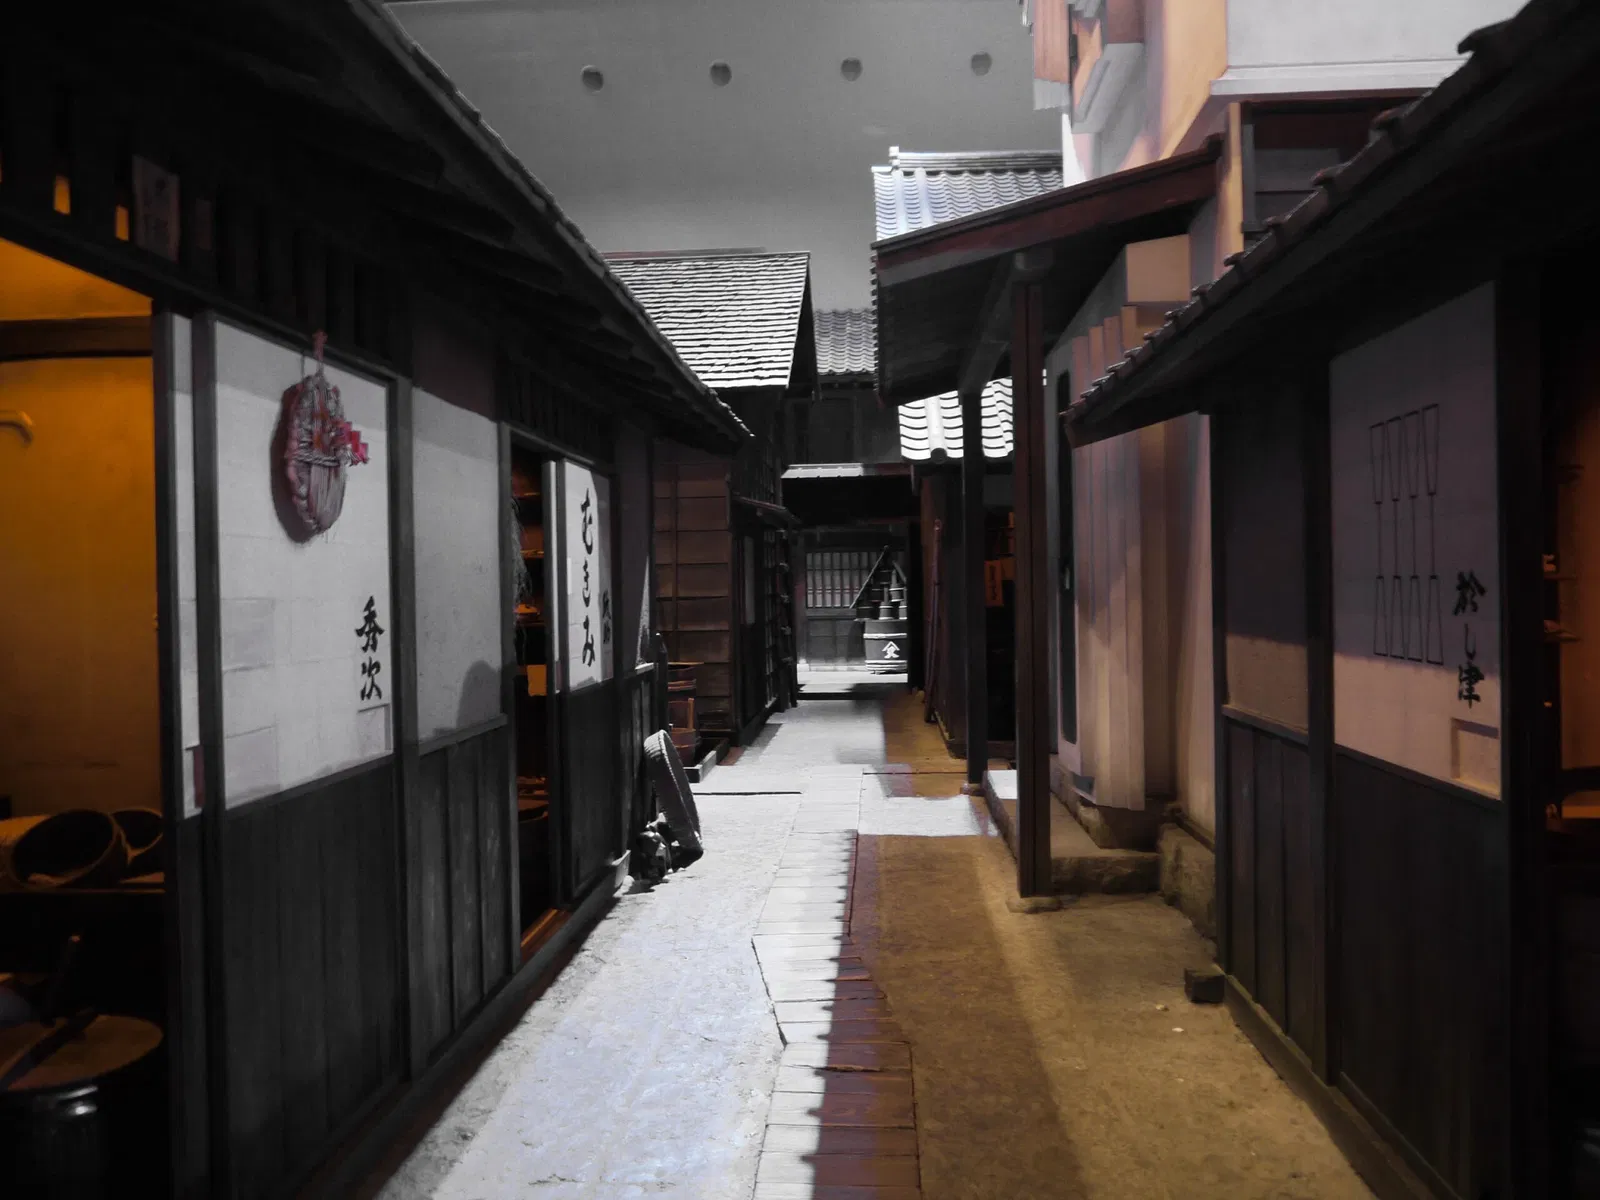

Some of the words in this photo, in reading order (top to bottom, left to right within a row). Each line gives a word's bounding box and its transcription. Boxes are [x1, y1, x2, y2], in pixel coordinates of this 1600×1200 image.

[354, 595, 386, 701] 秀次
[580, 487, 596, 668] むきみ
